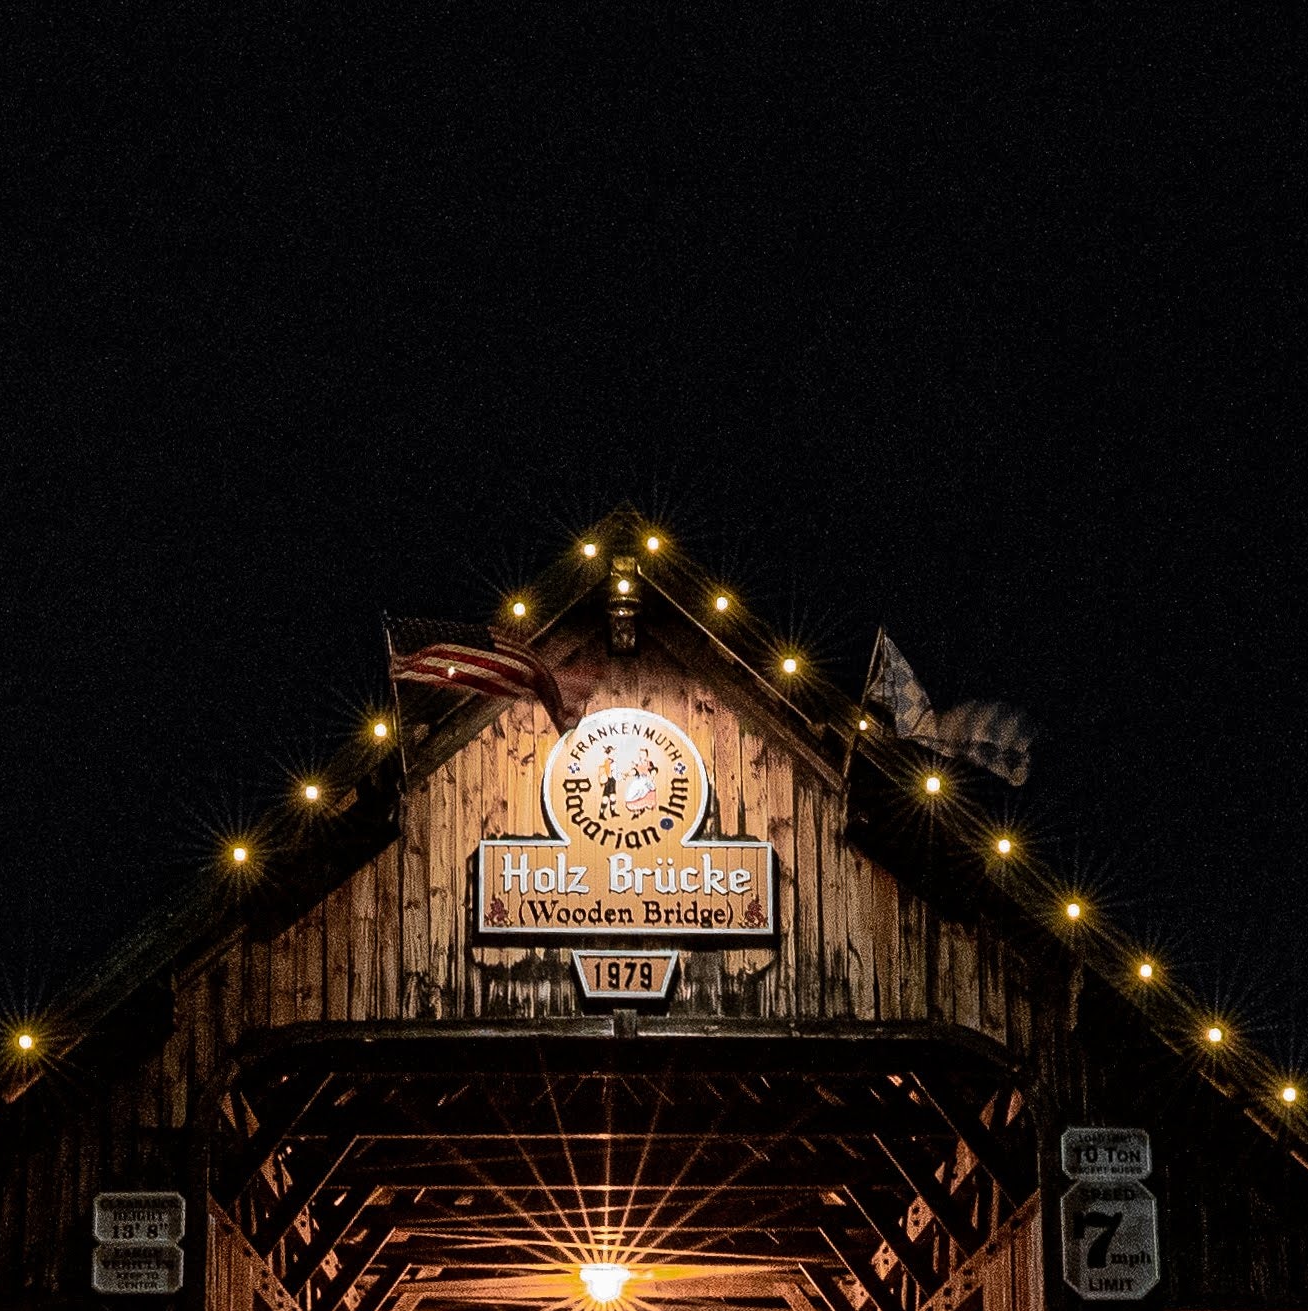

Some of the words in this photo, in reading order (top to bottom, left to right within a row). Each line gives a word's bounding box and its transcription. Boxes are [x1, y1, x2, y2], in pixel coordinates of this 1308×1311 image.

[570, 721, 683, 762] FRANKENMUTH
[562, 776, 662, 849] Bavarian
[658, 777, 689, 821] Inn
[500, 852, 589, 895] Holz
[606, 852, 753, 895] Brücke
[518, 899, 634, 925] (Wooden
[642, 899, 733, 927] Bridge)
[594, 961, 653, 989] 1979
[1072, 1146, 1098, 1163] 10
[1080, 1188, 1136, 1200] SPEED
[1073, 1211, 1123, 1269] 7
[1111, 1251, 1151, 1267] mph
[1089, 1278, 1134, 1291] LIMIT
